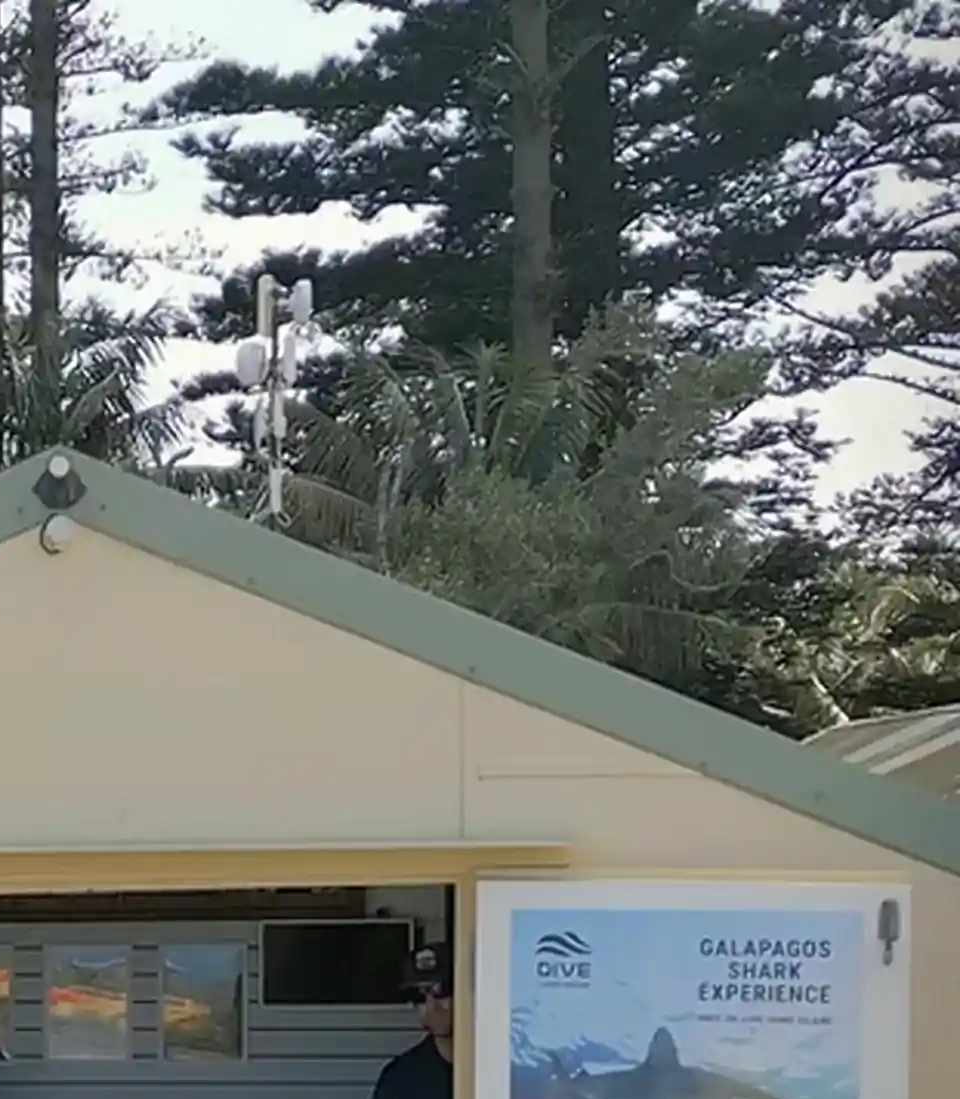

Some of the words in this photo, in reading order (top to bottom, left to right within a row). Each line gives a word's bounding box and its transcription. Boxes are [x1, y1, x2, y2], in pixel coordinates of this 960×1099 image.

[698, 938, 832, 959] GALAPAGOS
[537, 962, 592, 979] DIVE
[727, 961, 802, 980] SHARK
[697, 982, 831, 1004] EXPERIENCE
